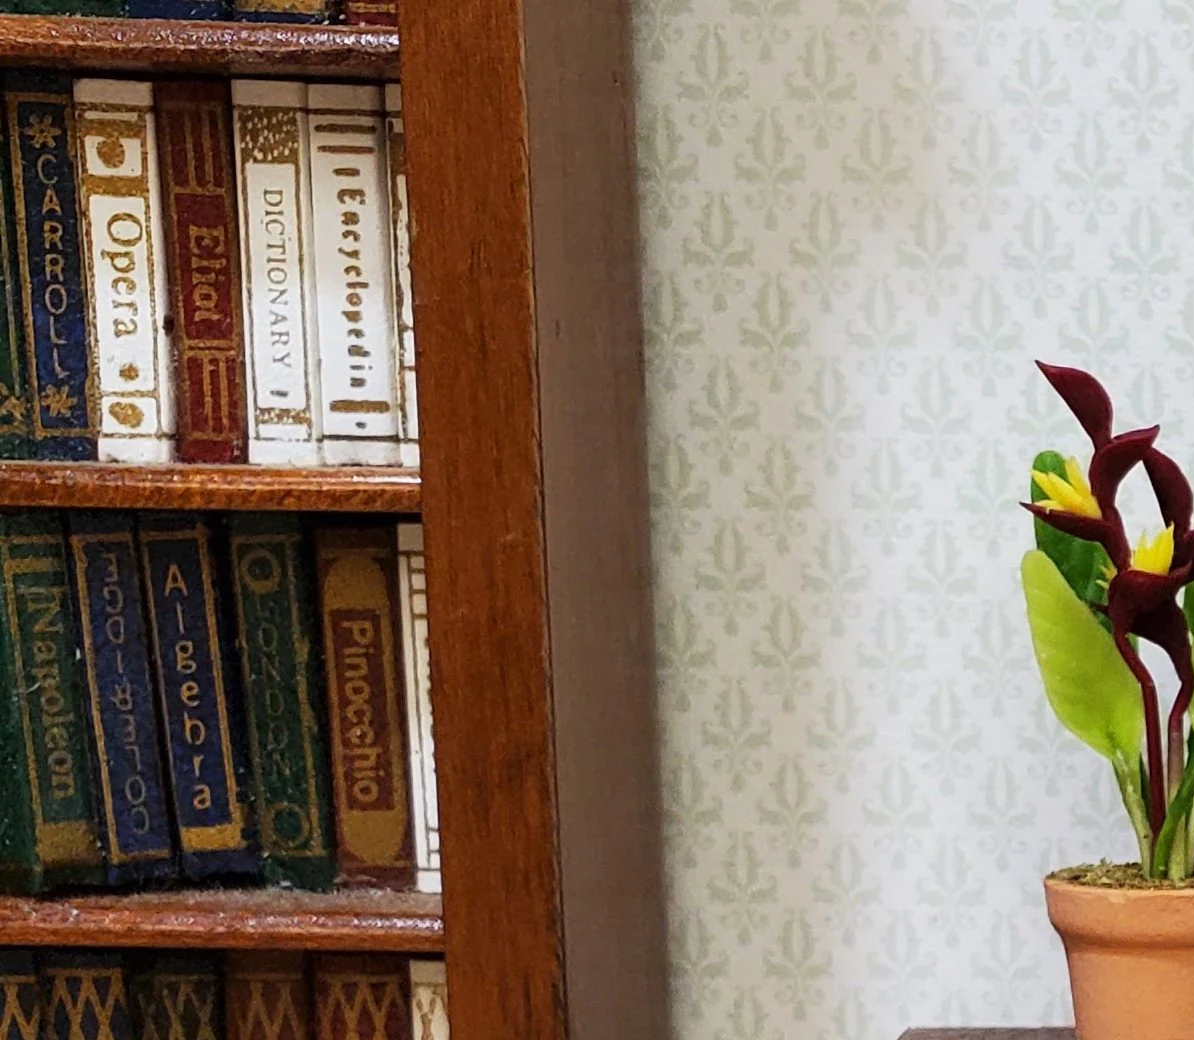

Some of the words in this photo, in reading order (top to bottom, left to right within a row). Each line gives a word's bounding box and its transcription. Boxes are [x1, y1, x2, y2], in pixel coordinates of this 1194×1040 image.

[36, 154, 69, 380] CARROLL
[101, 211, 144, 338] Opera
[188, 223, 228, 322] Eliot
[263, 188, 292, 369] DICTIONARY
[22, 585, 76, 799] Napoleon
[102, 552, 150, 834] COLERIDGE
[164, 563, 212, 811] Algebra
[342, 620, 382, 804] Pinocchio
